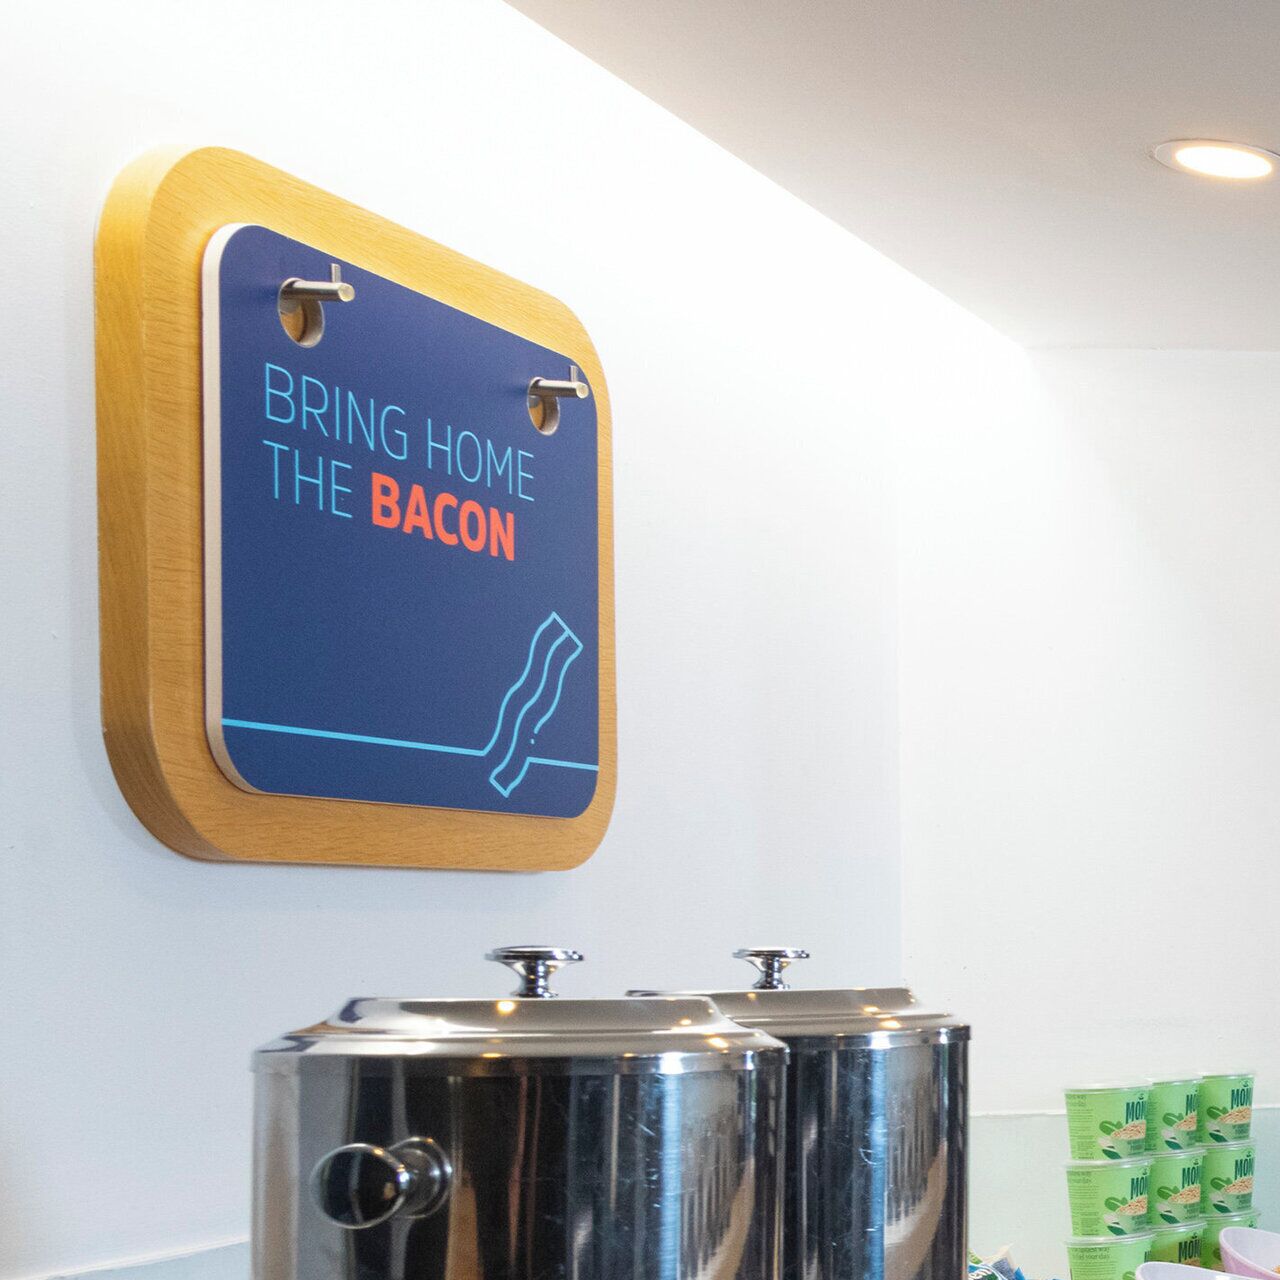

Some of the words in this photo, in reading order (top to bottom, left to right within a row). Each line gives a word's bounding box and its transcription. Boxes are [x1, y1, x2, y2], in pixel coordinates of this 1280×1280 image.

[264, 362, 408, 461] BRING
[427, 417, 535, 502] HOME
[262, 439, 353, 518] THE
[371, 471, 515, 561] BACON
